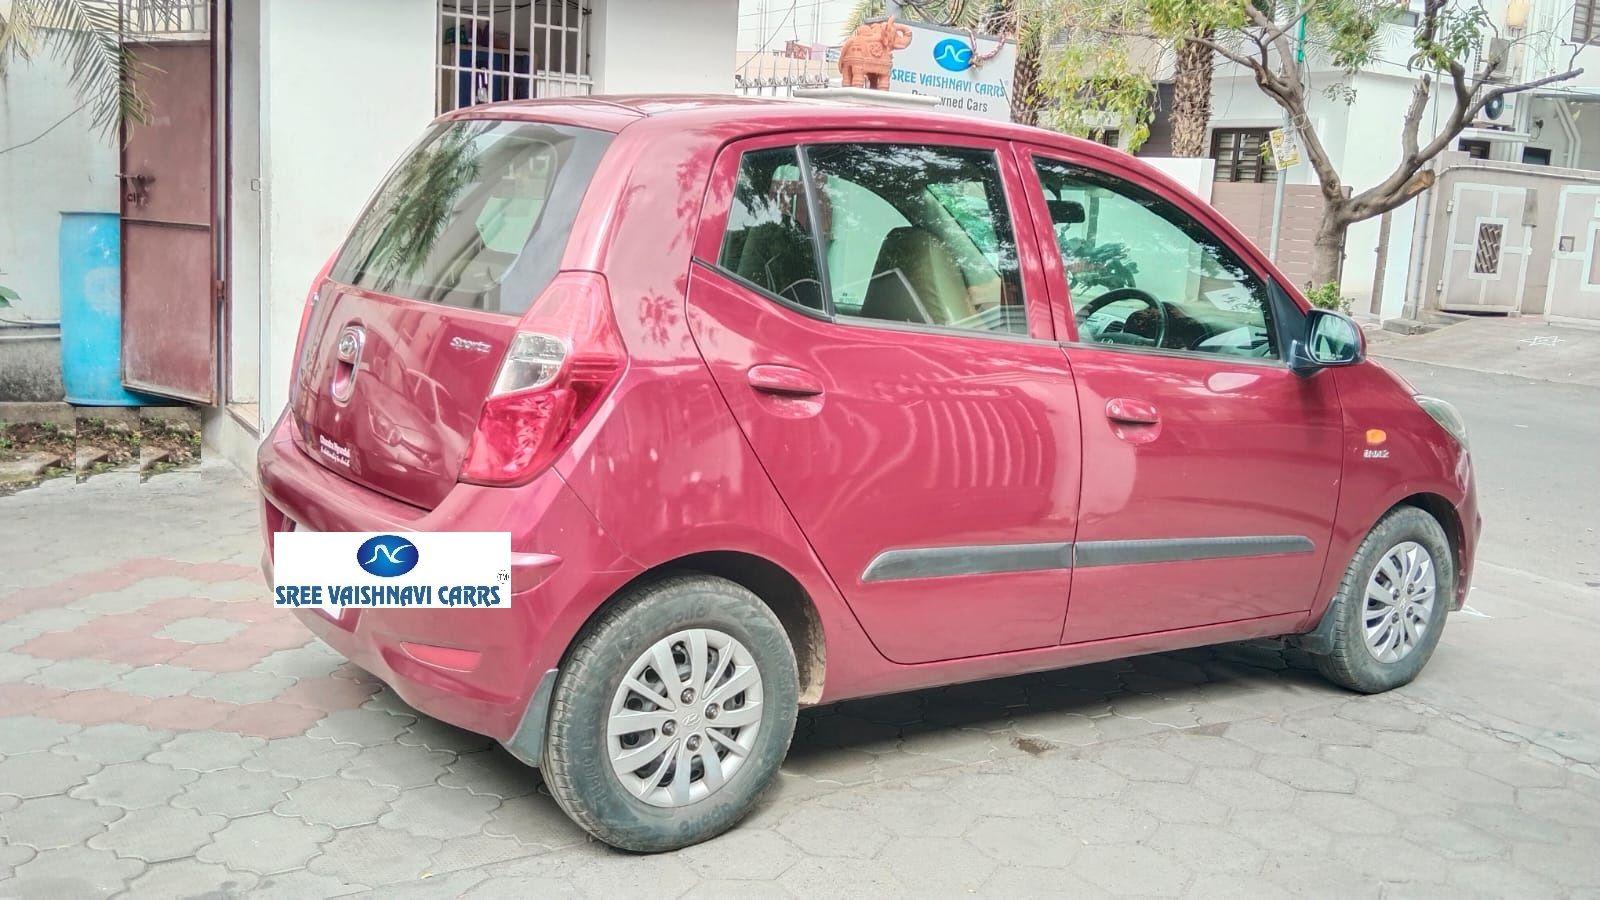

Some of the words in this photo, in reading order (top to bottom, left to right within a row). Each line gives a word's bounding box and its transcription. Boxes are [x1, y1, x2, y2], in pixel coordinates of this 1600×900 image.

[891, 69, 917, 84] SREE
[919, 73, 972, 93] VAISHNAVI
[974, 82, 1005, 98] CARRS
[966, 98, 988, 113] Cars
